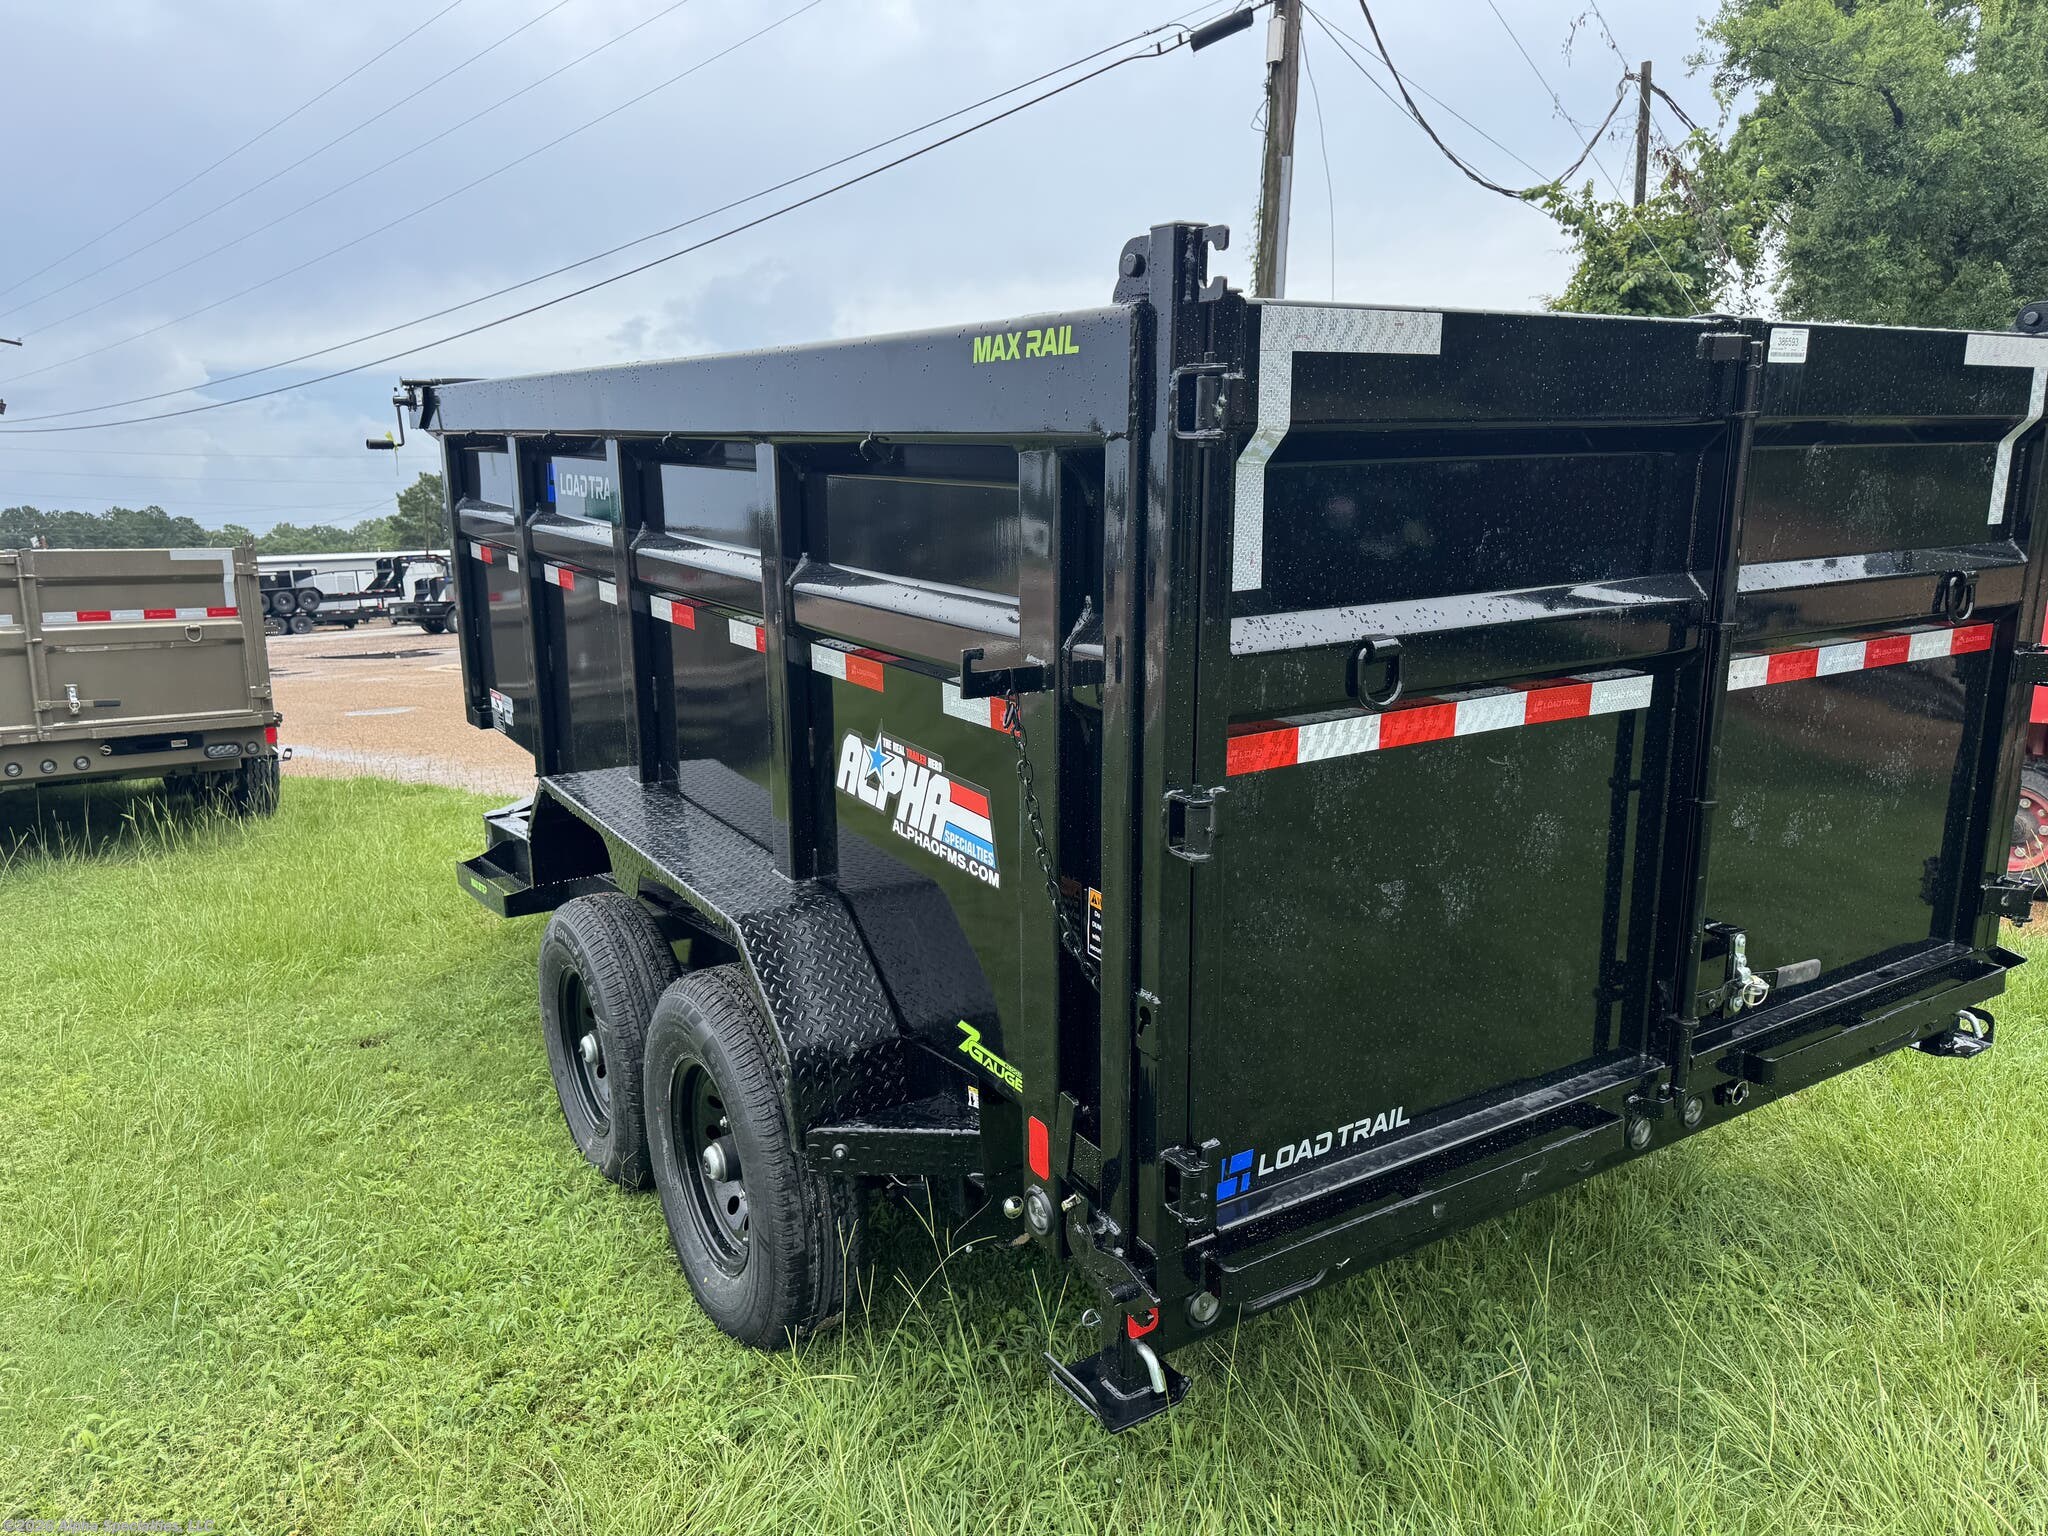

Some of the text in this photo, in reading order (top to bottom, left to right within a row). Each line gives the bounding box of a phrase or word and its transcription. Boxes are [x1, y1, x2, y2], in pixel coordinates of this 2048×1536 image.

[973, 325, 1079, 363] MAX RAIL
[560, 473, 587, 497] LOAD
[837, 733, 951, 842] ALPHA
[893, 820, 1000, 888] ALPHAOFMS.COM
[944, 829, 994, 866] SPECIALTIES
[968, 1040, 1023, 1093] GAUGE
[1258, 1106, 1410, 1177] LOAD TRAIL
